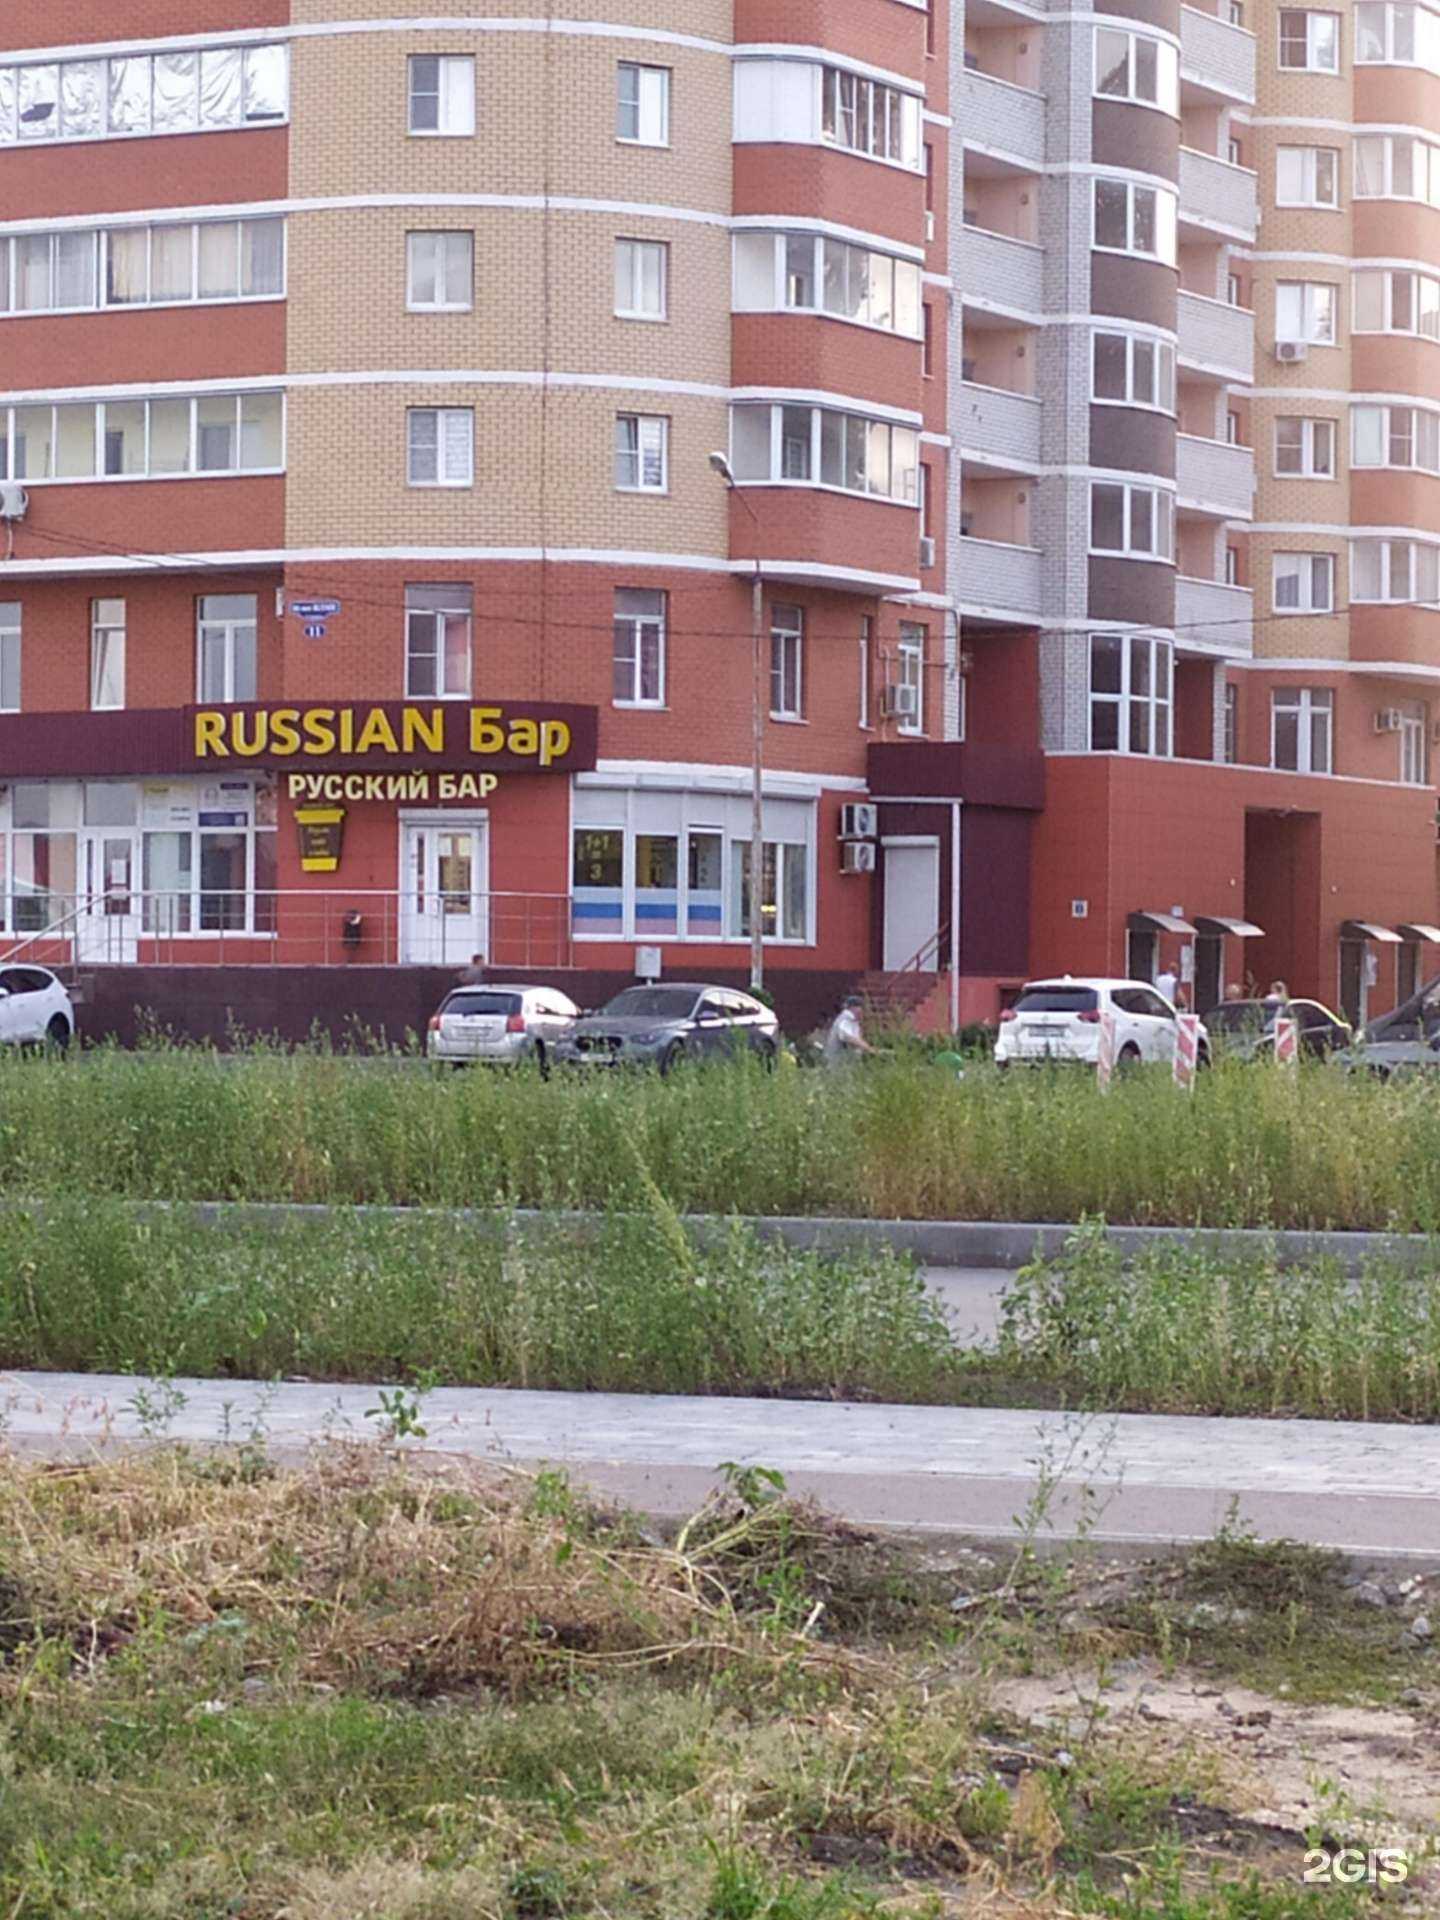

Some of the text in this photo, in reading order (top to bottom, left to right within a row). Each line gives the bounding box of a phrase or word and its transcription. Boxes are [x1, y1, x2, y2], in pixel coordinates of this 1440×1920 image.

[310, 625, 320, 638] 11
[194, 707, 571, 765] RUSSIAN Бар
[288, 769, 499, 800] РУССКИЙ БАР
